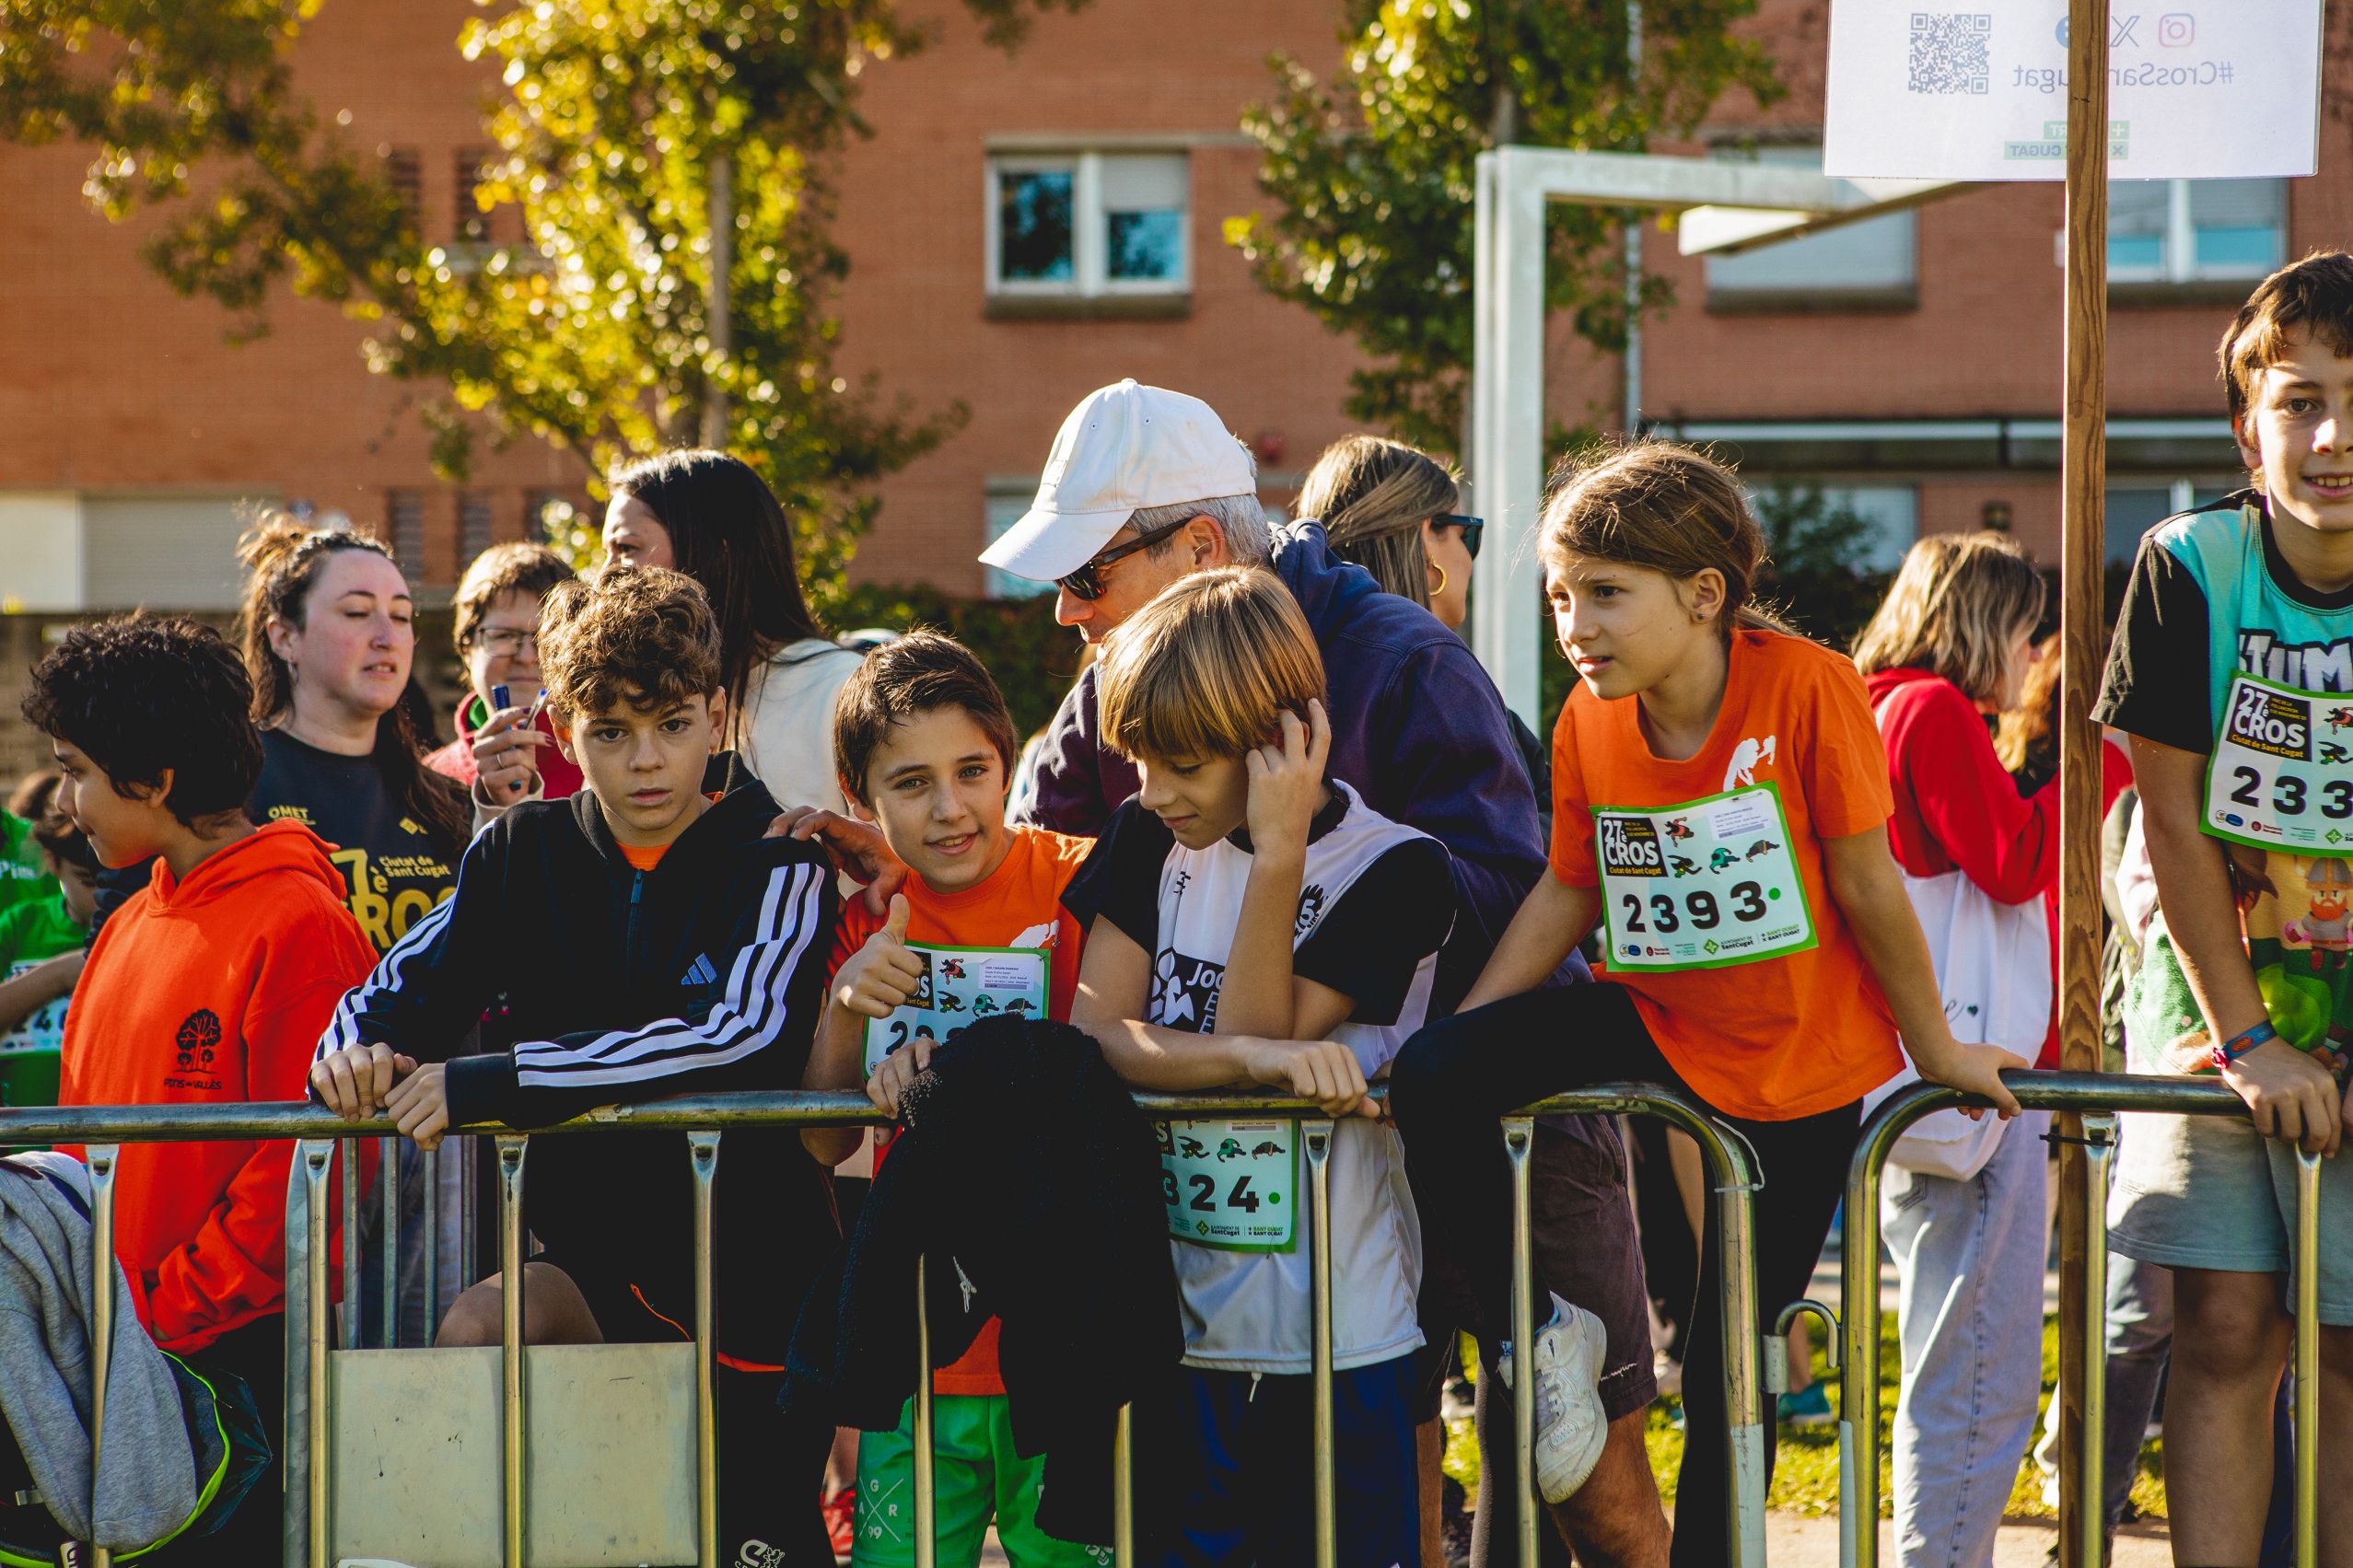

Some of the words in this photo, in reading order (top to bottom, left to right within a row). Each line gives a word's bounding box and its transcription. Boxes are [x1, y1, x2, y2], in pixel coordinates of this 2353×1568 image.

[2234, 709, 2306, 748] CROS
[2261, 743, 2279, 753] Sant
[2279, 747, 2305, 759] Cugat
[379, 855, 417, 867] Ciutat
[416, 854, 434, 865] de
[1605, 841, 1660, 866] CROS
[384, 865, 416, 877] Sant
[414, 863, 451, 878] Cugat
[1644, 867, 1662, 877] Cugat
[1622, 880, 1767, 934] 2393
